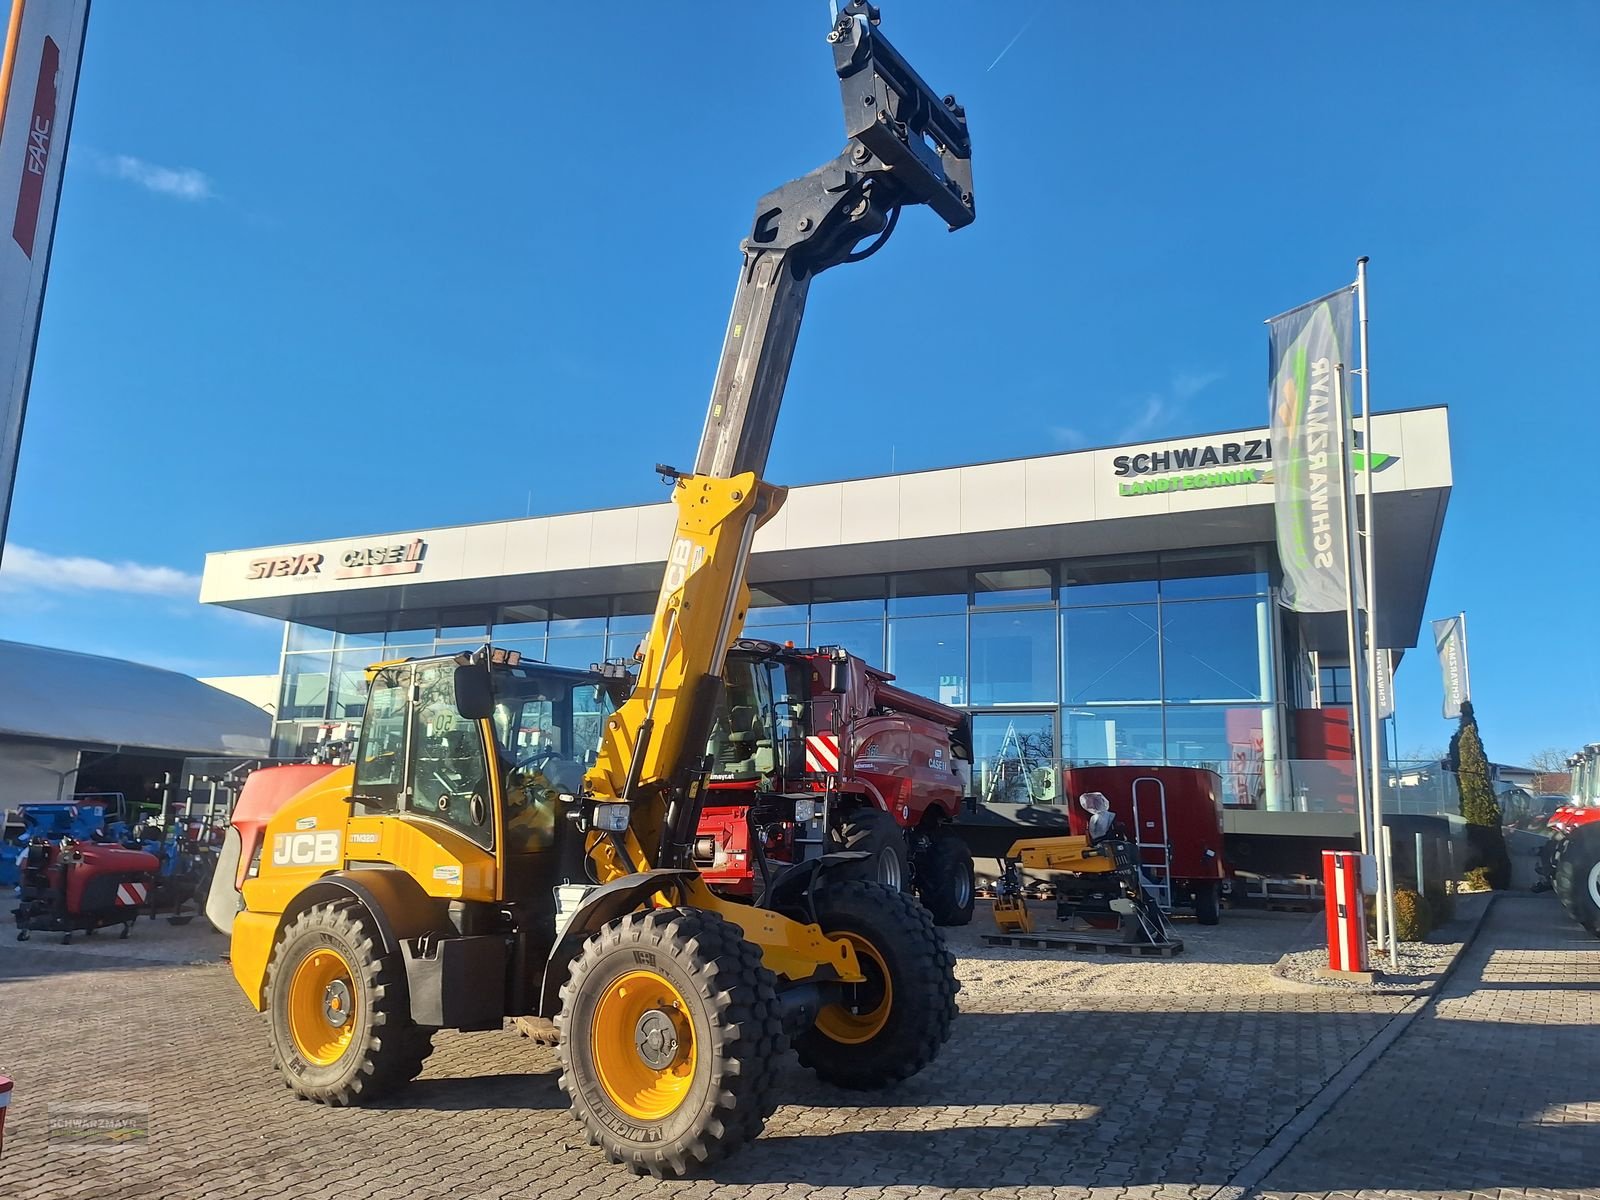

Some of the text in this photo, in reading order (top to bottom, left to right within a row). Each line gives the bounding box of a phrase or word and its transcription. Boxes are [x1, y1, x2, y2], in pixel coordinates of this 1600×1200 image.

[28, 115, 50, 176] FAAC
[1113, 437, 1273, 476] SCHWARZ
[1119, 468, 1258, 497] LANDTECHNIK
[247, 552, 324, 580] STEYR
[273, 833, 338, 865] JCB
